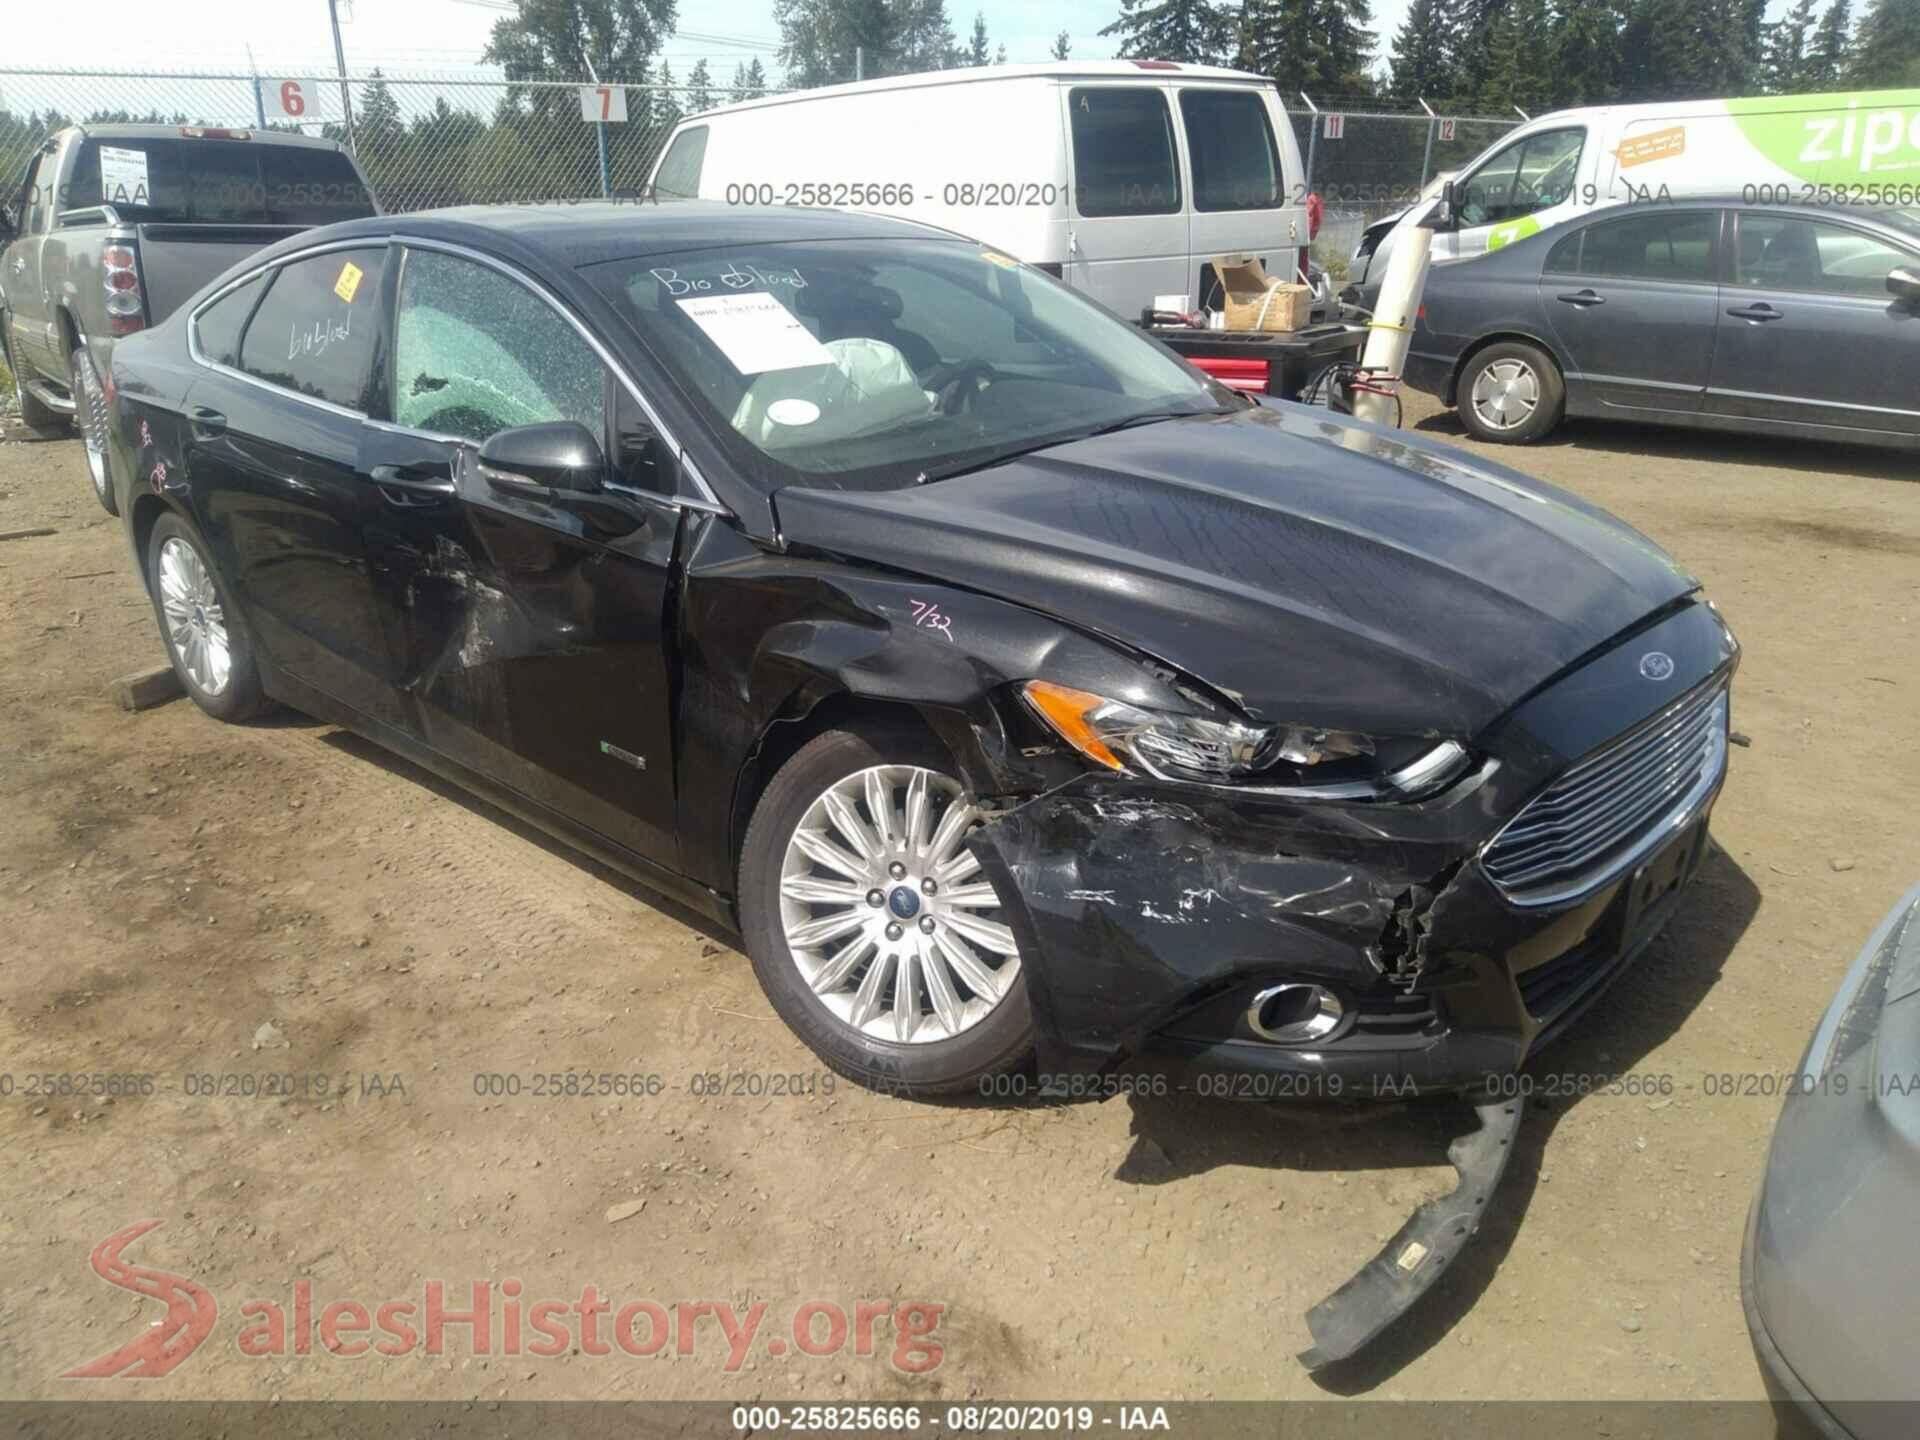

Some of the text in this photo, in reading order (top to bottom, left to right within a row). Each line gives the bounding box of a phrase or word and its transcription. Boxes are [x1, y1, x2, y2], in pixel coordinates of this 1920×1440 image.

[280, 81, 305, 117] 6
[595, 88, 613, 121] 7
[1327, 115, 1340, 139] 11
[1442, 119, 1455, 140] 12
[910, 599, 954, 643] 7/32
